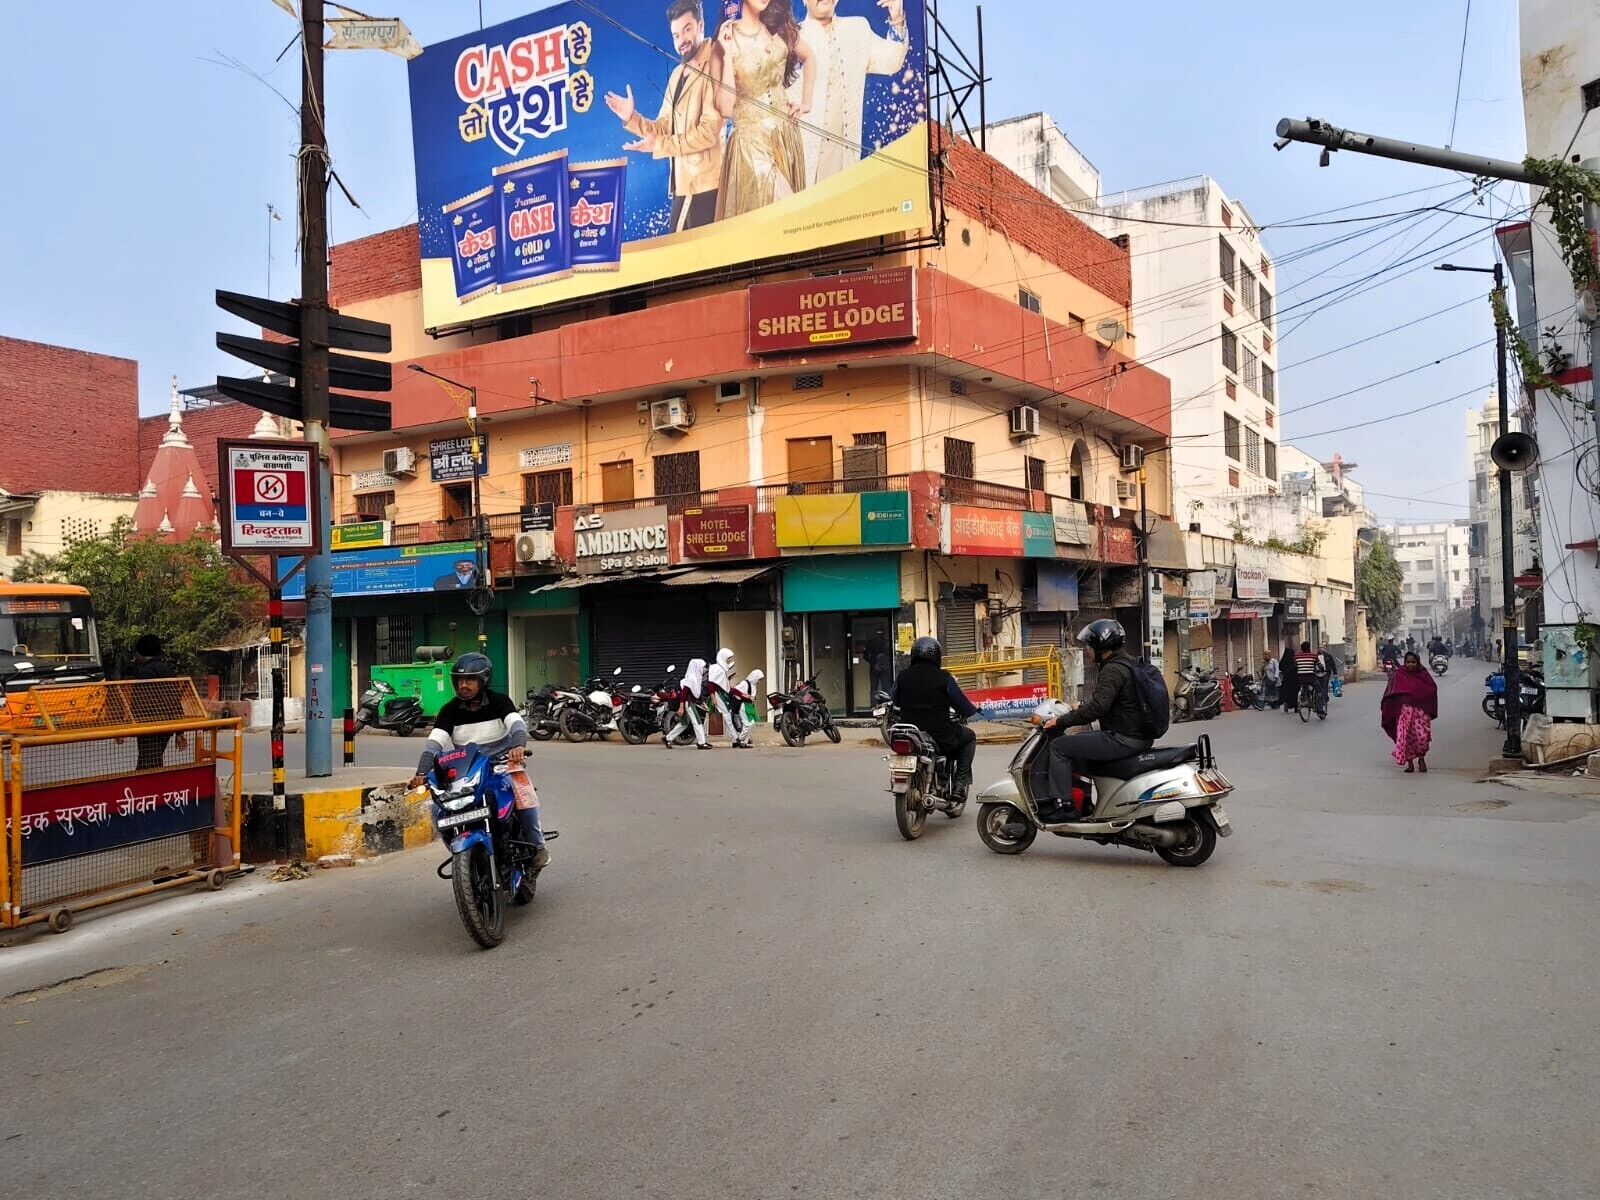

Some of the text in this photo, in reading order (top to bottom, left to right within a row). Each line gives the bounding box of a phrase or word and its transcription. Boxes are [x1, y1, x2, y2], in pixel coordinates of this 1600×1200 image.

[458, 26, 587, 99] CASH है
[462, 108, 483, 137] तो
[573, 74, 589, 107] है
[510, 204, 554, 238] CASH
[522, 240, 543, 256] GOLD
[521, 255, 545, 266] ELAICHI
[799, 289, 860, 310] HOTEL
[757, 303, 905, 337] SHREE LODGE
[431, 440, 456, 453] SHREE
[456, 435, 485, 449] LODE
[433, 454, 450, 470] श्री
[574, 513, 604, 531] AS
[700, 519, 731, 530] HOTEL
[953, 512, 1005, 541] आईडीबीआई
[575, 524, 668, 558] AMBIENCE
[686, 531, 747, 545] SHREE LODGE
[623, 556, 633, 568] &
[635, 554, 668, 567] Salon
[1237, 569, 1263, 582] Trackon
[438, 751, 467, 766] PRESS
[116, 787, 160, 818] जीवन
